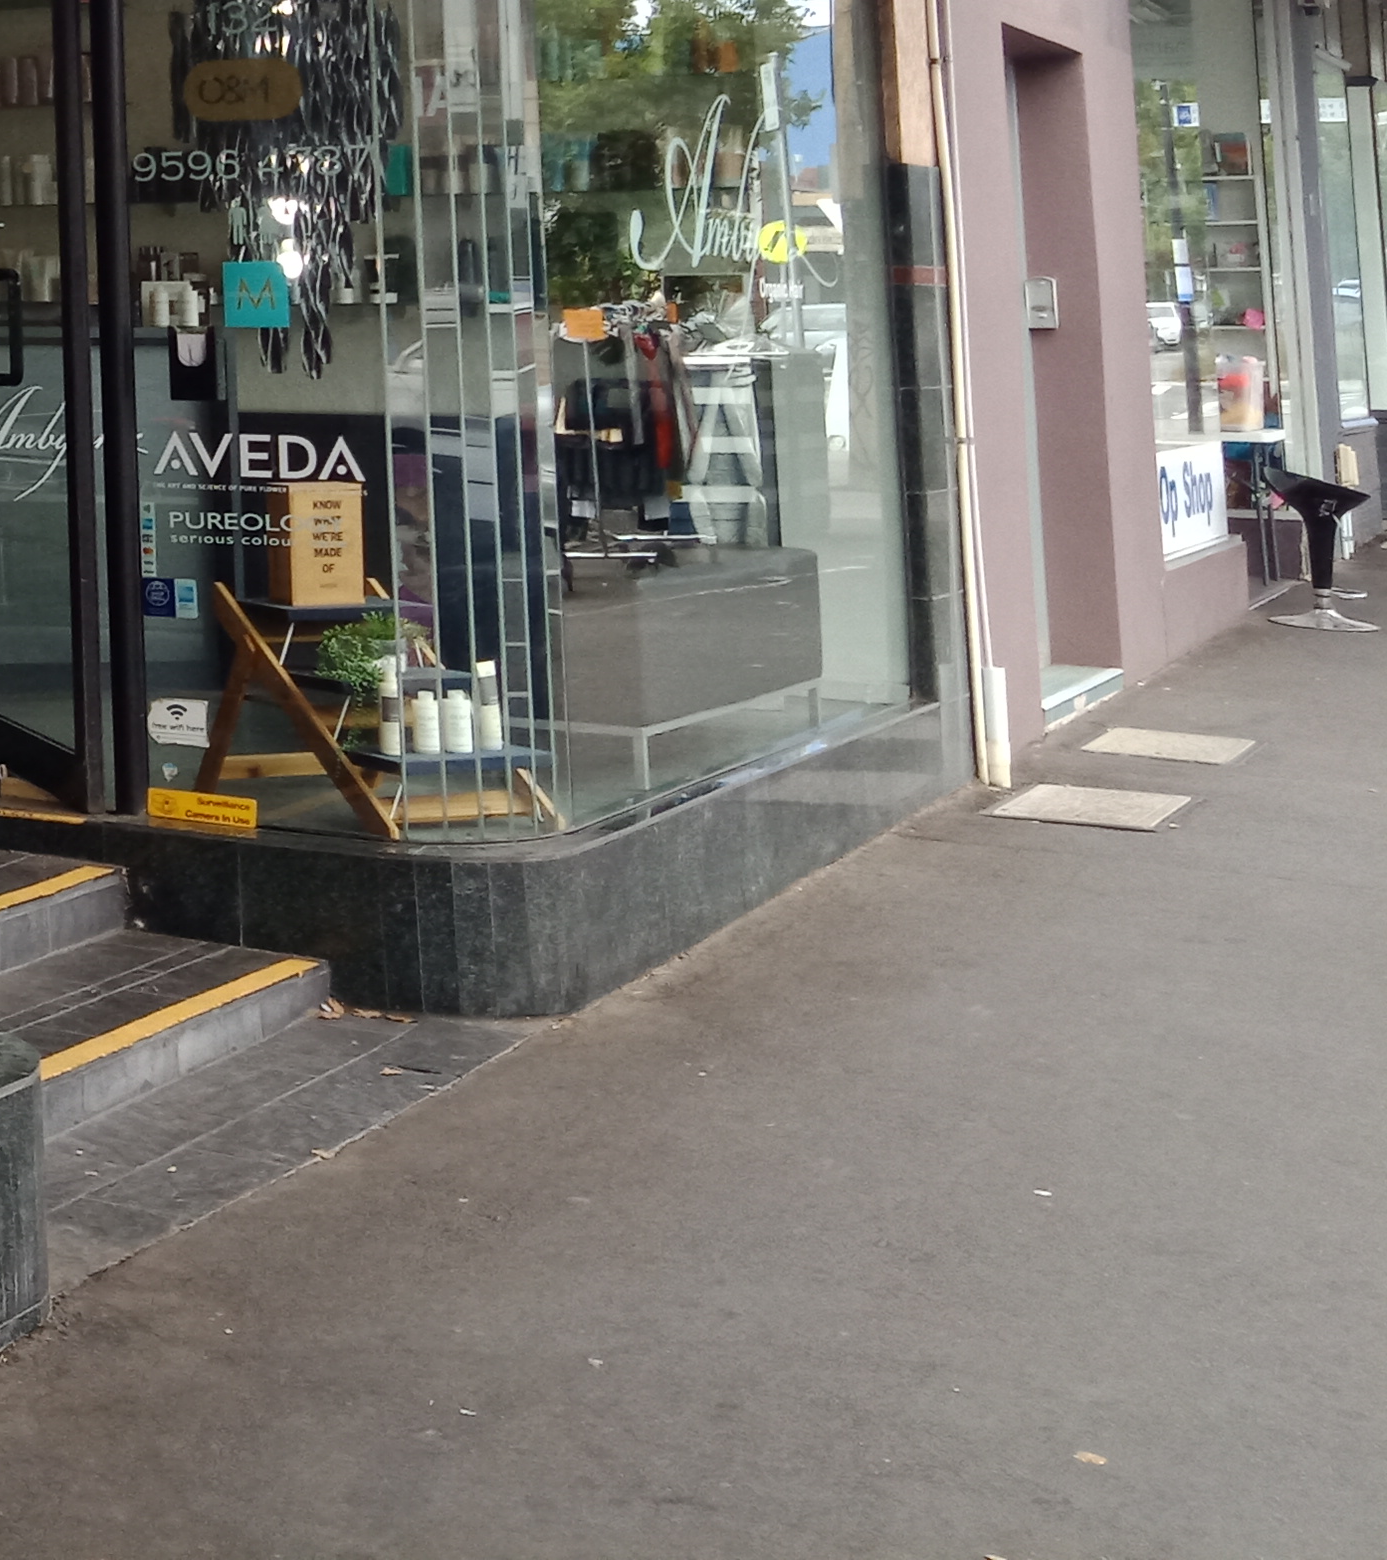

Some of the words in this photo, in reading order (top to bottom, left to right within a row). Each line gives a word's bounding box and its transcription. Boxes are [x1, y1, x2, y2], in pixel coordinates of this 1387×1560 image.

[131, 149, 241, 183] 9596
[153, 430, 366, 482] AVEDA
[1159, 466, 1178, 538] Op
[1183, 460, 1214, 527] Shop
[169, 533, 235, 546] serious
